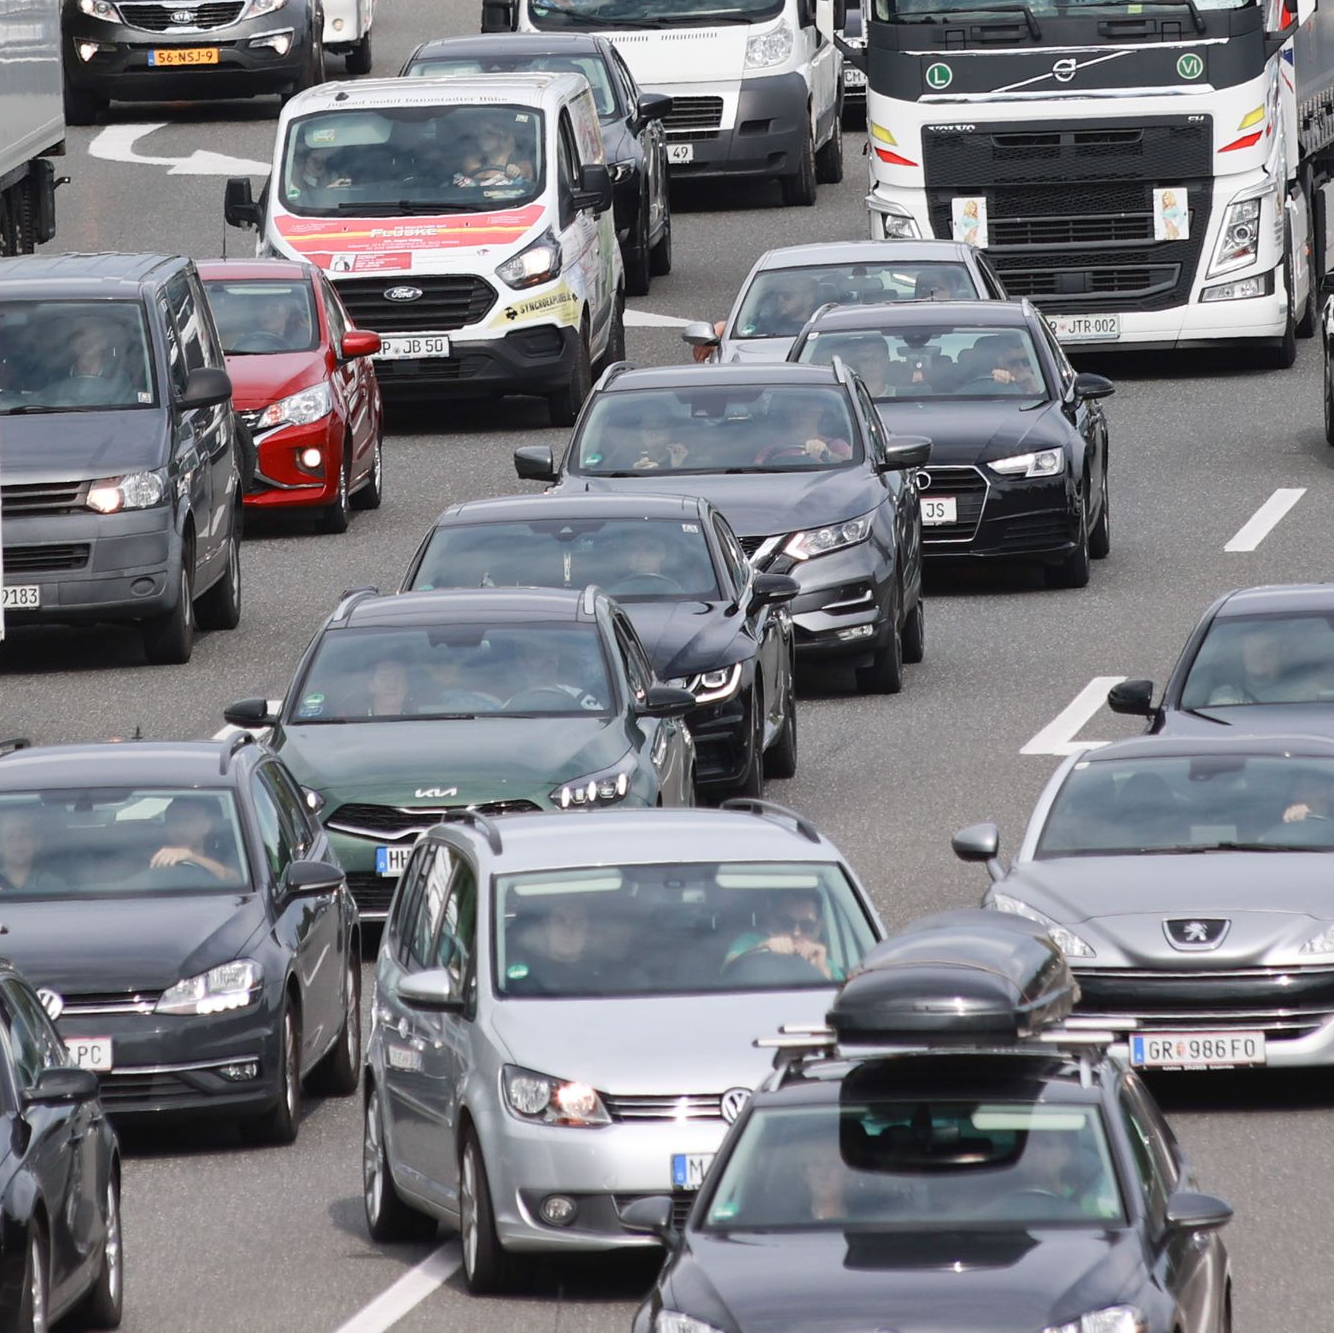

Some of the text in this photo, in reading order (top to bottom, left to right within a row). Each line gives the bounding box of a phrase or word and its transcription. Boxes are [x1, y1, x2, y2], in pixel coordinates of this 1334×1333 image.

[158, 50, 213, 63] 56-NSJ-9
[673, 146, 689, 158] 49
[391, 288, 414, 298] Ford
[1068, 319, 1116, 334] JTR-002
[403, 340, 421, 354] JB
[425, 339, 443, 353] 50
[926, 502, 944, 518] JS
[1149, 1040, 1173, 1059] GR
